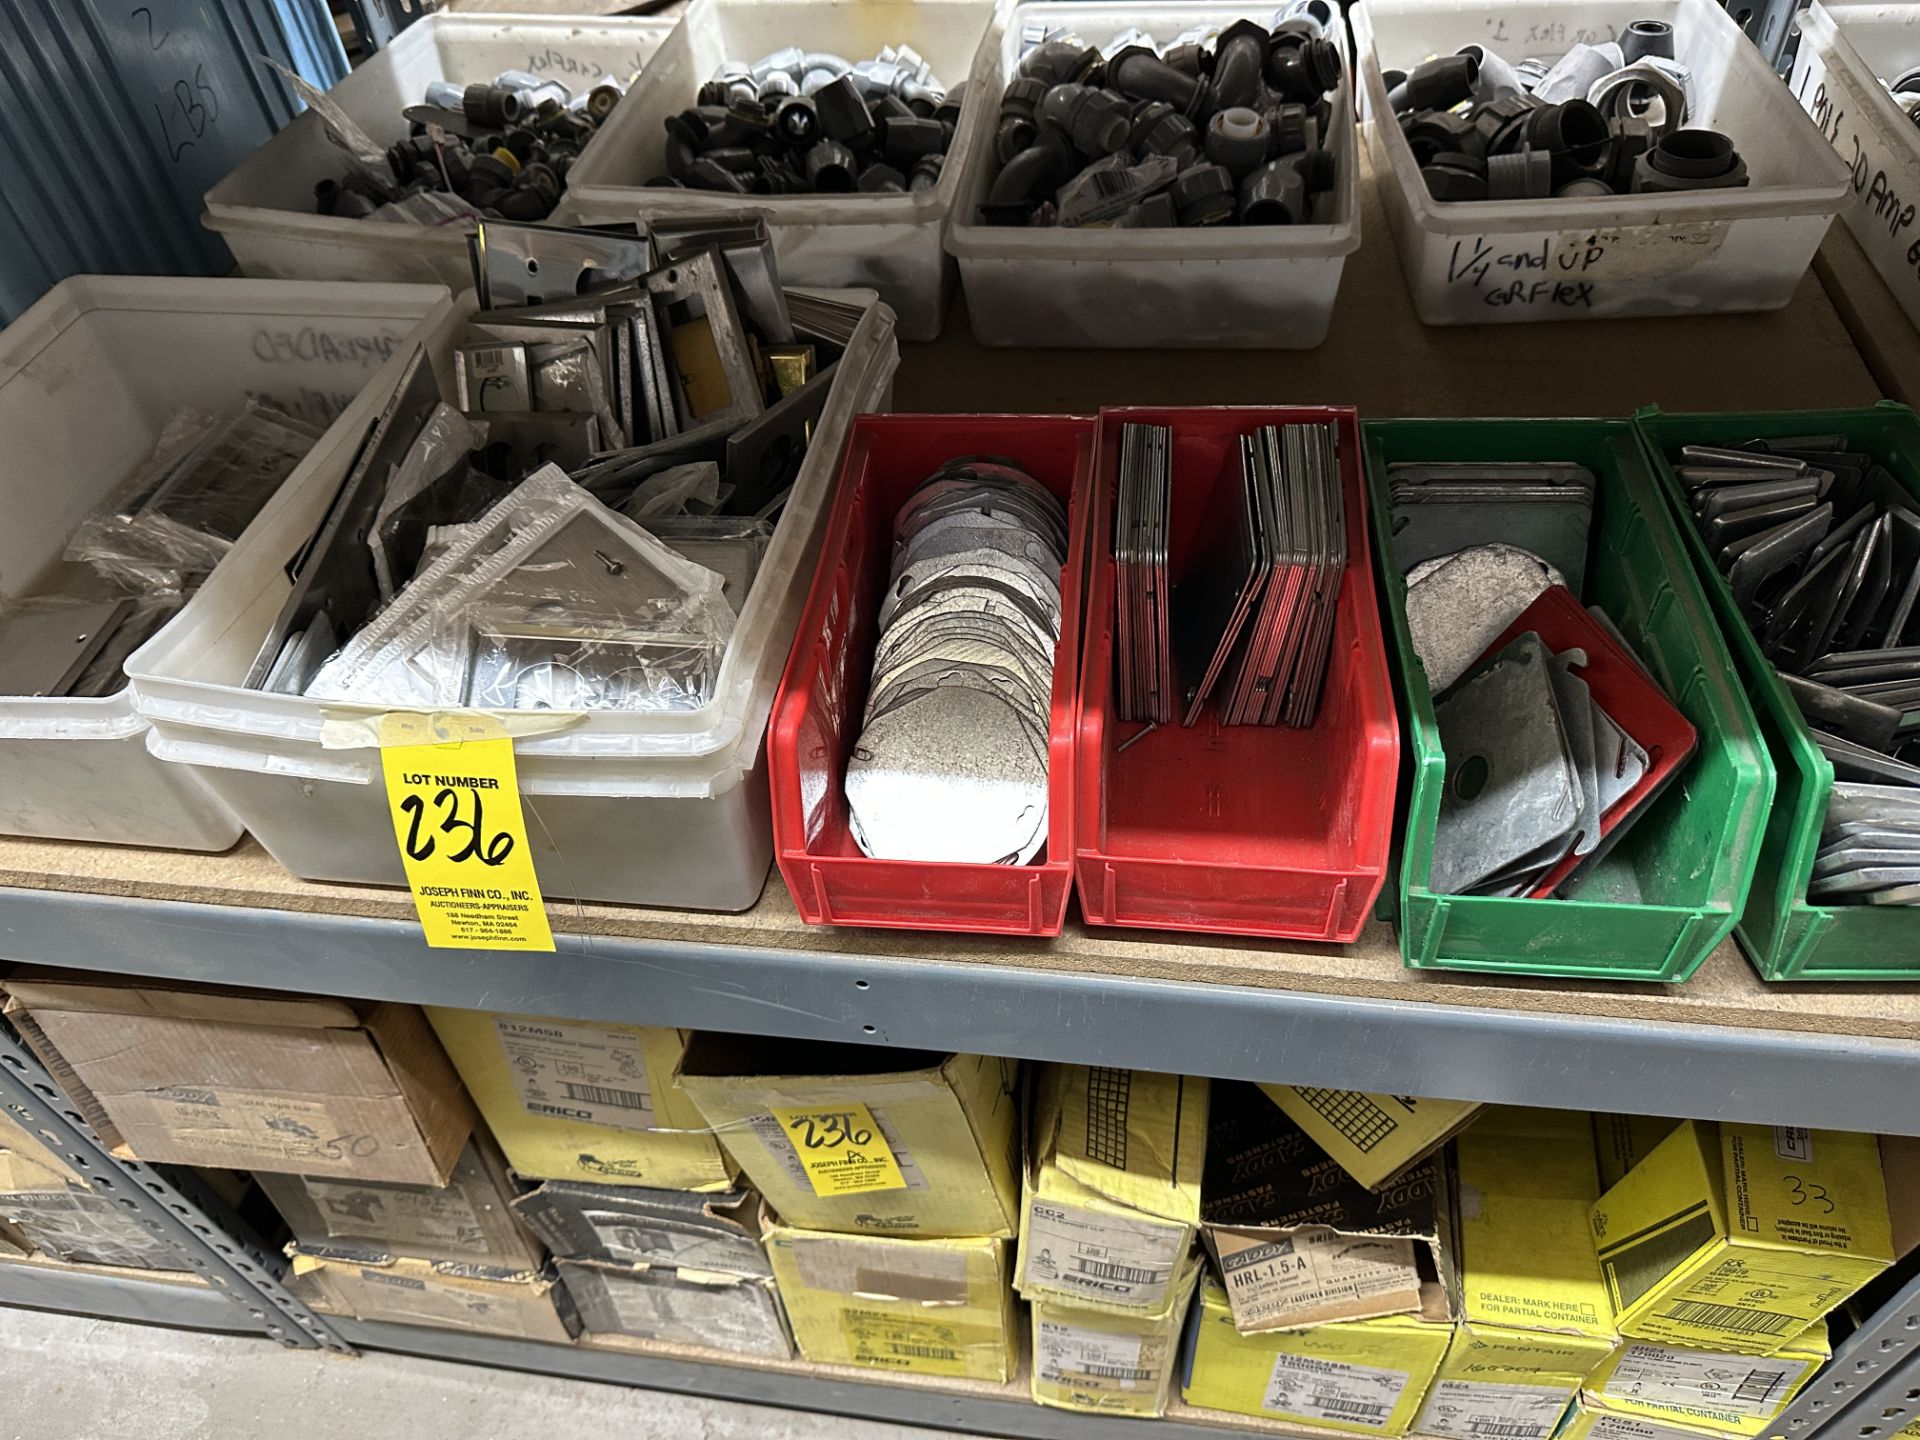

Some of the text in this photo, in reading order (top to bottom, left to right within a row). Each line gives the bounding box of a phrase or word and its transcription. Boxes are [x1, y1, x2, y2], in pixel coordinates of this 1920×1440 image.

[131, 7, 169, 50] 2
[403, 773, 499, 789] LOT NUMBER
[400, 788, 515, 866] 236
[419, 886, 533, 901] JOSEPH FINN CO., INC.
[790, 1114, 873, 1149] 236
[810, 1159, 839, 1169] JOSEPH
[1783, 1175, 1835, 1214] 33
[1735, 1186, 1746, 1231] CONTAINER
[1223, 1240, 1291, 1270] CADDY
[1062, 1273, 1133, 1293] ERICO
[1480, 1292, 1579, 1312] DEALER: MARK HERE
[1480, 1302, 1599, 1325] FOR PARTIAL CONTAINER
[1492, 1344, 1576, 1356] PENTAIR
[1322, 1411, 1384, 1426] ERICO
[1687, 1407, 1742, 1425] CONTAINER
